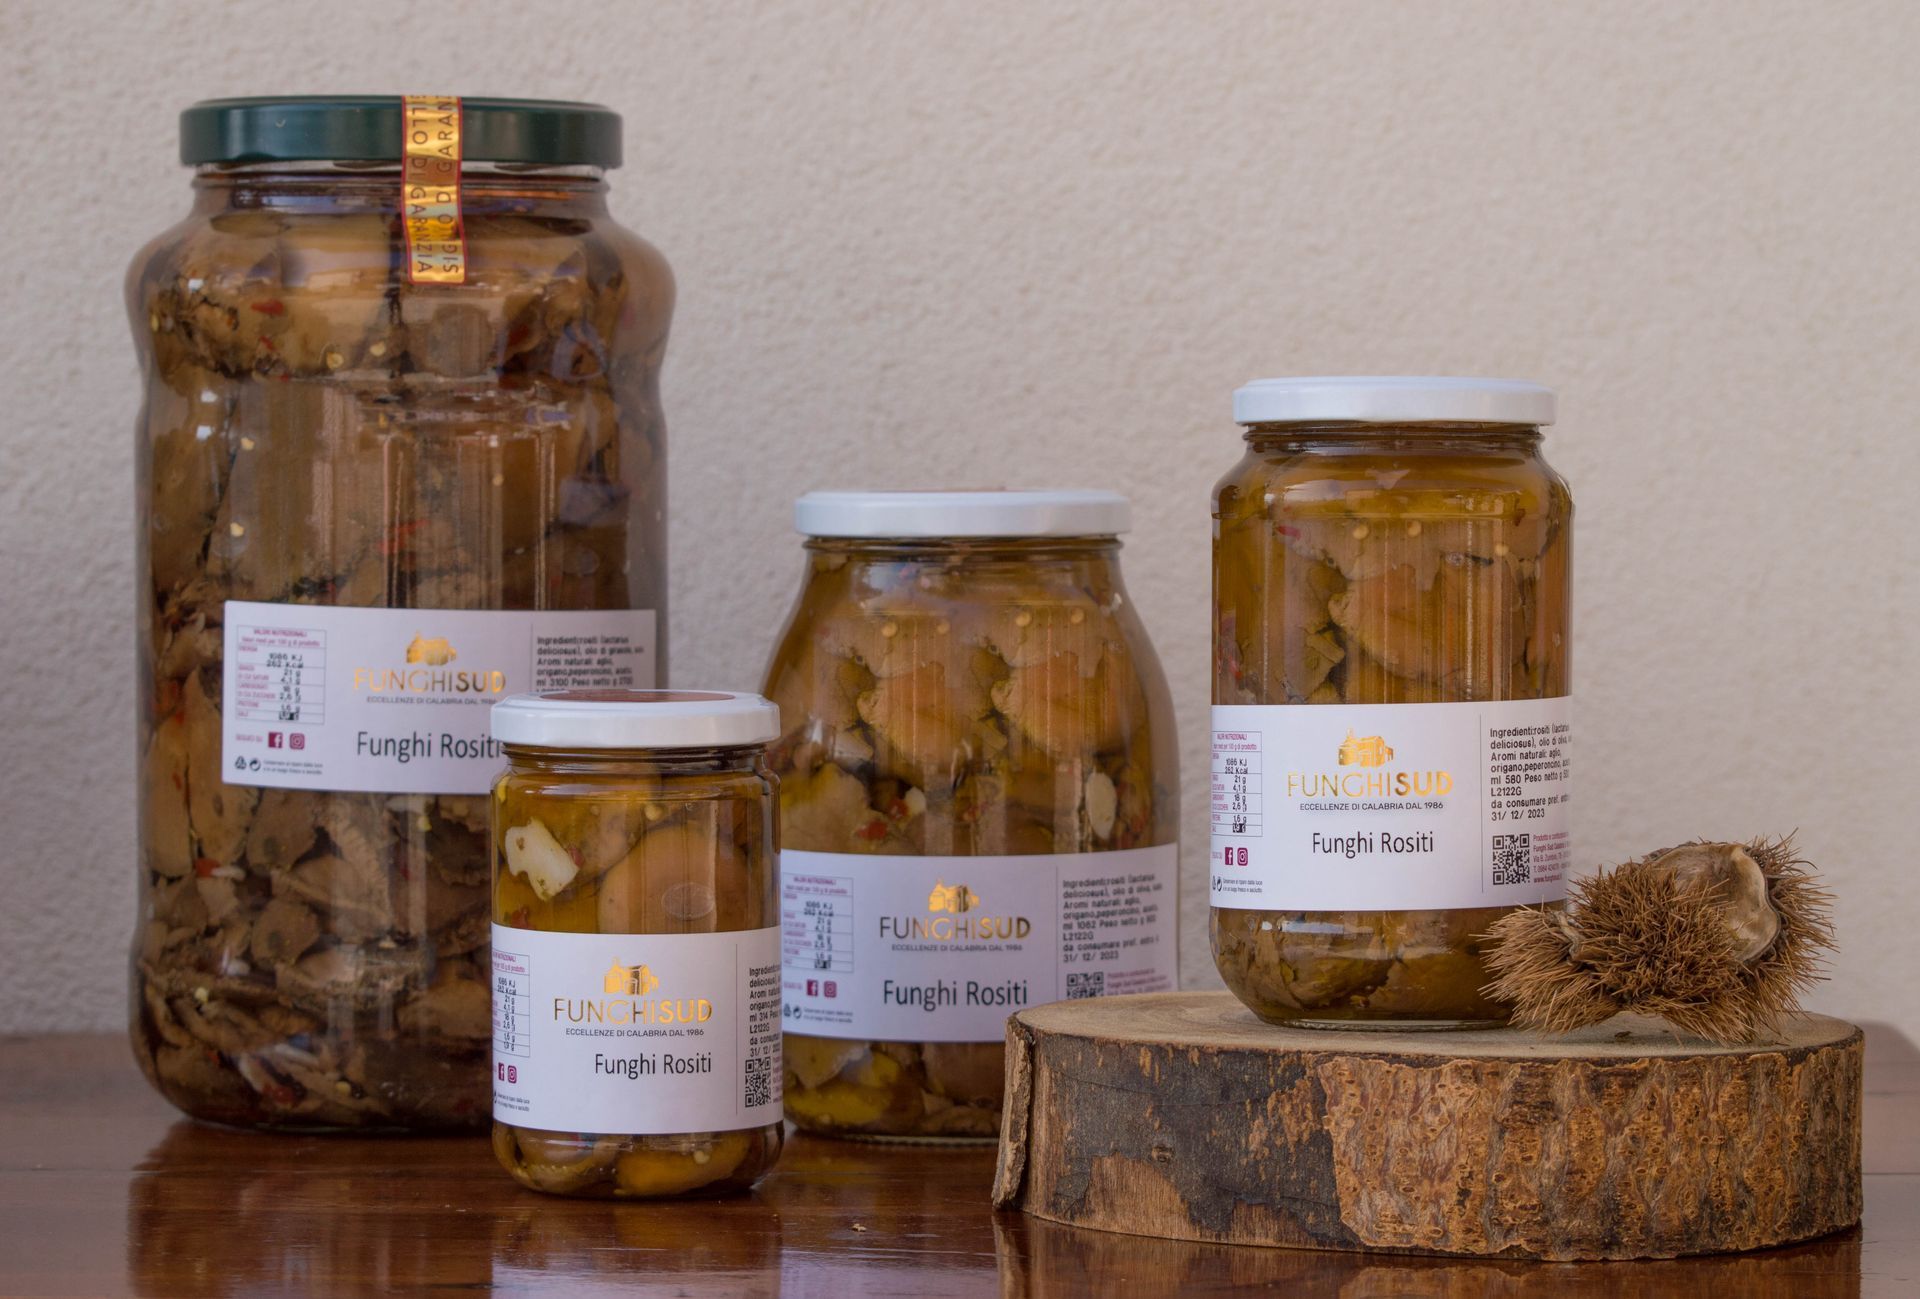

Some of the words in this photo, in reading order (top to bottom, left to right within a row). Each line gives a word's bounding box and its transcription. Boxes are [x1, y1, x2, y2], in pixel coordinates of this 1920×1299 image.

[411, 96, 429, 145] ILLO
[436, 96, 454, 173] GARAN
[411, 157, 427, 177] DI
[410, 187, 433, 273] GARANZIA
[354, 668, 506, 694] FUNGHISUD
[367, 696, 414, 704] ECCELLENZE
[425, 697, 462, 705] CALABRIA
[357, 731, 432, 764] Funghi
[1490, 751, 1517, 762] Aromi
[1287, 770, 1454, 797] FUNGHISUD
[1490, 774, 1501, 785] ml
[1505, 774, 1521, 785] 580
[1524, 773, 1542, 783] Peso
[1490, 786, 1522, 797] L2122G
[1299, 803, 1349, 811] ECCELLENZE
[1352, 803, 1360, 811] DI
[1362, 802, 1404, 811] CALABRIA
[1406, 802, 1422, 810] DAL
[1424, 801, 1444, 810] 1986
[1491, 799, 1502, 809] da
[1505, 797, 1546, 808] consumare
[1491, 811, 1507, 822] 31/
[1510, 809, 1524, 820] 12/
[1527, 808, 1545, 819] 2023
[1312, 831, 1373, 859] Funghi
[1381, 831, 1434, 853] Rositi
[1063, 900, 1088, 909] Aromi
[879, 916, 1031, 940] FUNGHISUD
[892, 943, 938, 951] ECCELLENZE
[949, 944, 987, 952] CALABRIA
[884, 979, 957, 1012] Funghi
[967, 979, 1028, 1006] Rositi
[554, 997, 712, 1025] FUNGHISUD
[566, 1028, 614, 1037] ECCELLENZE
[616, 1029, 625, 1037] DI
[626, 1029, 667, 1037] CALABRIA
[669, 1029, 685, 1037] DAL
[686, 1028, 704, 1036] 1986
[595, 1053, 656, 1080] Funghi
[663, 1052, 711, 1075] Rositi
